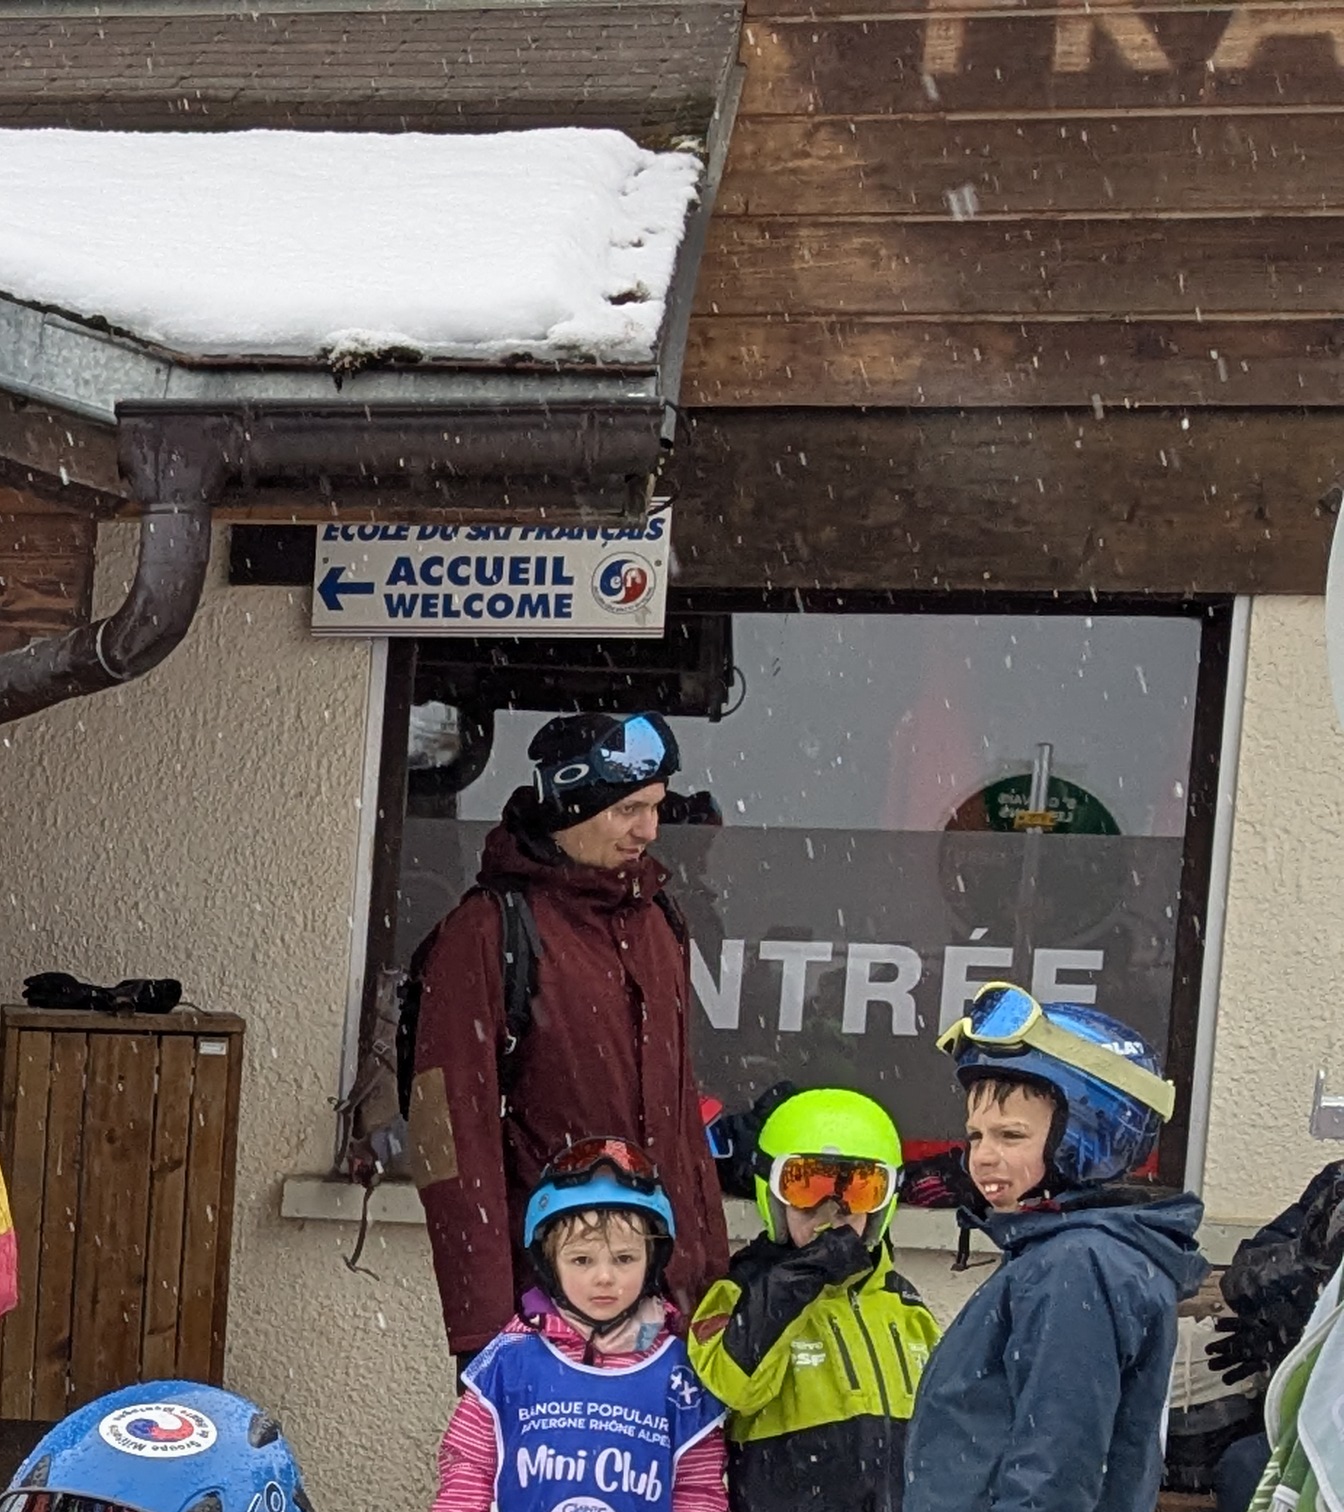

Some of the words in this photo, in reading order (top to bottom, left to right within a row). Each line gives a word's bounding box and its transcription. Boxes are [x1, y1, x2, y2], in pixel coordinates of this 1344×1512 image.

[385, 556, 575, 586] ACCUEIL
[385, 592, 574, 620] WELCOME
[689, 927, 1104, 1036] NTRÉE
[517, 1444, 587, 1488] Mini
[595, 1447, 662, 1502] Club
